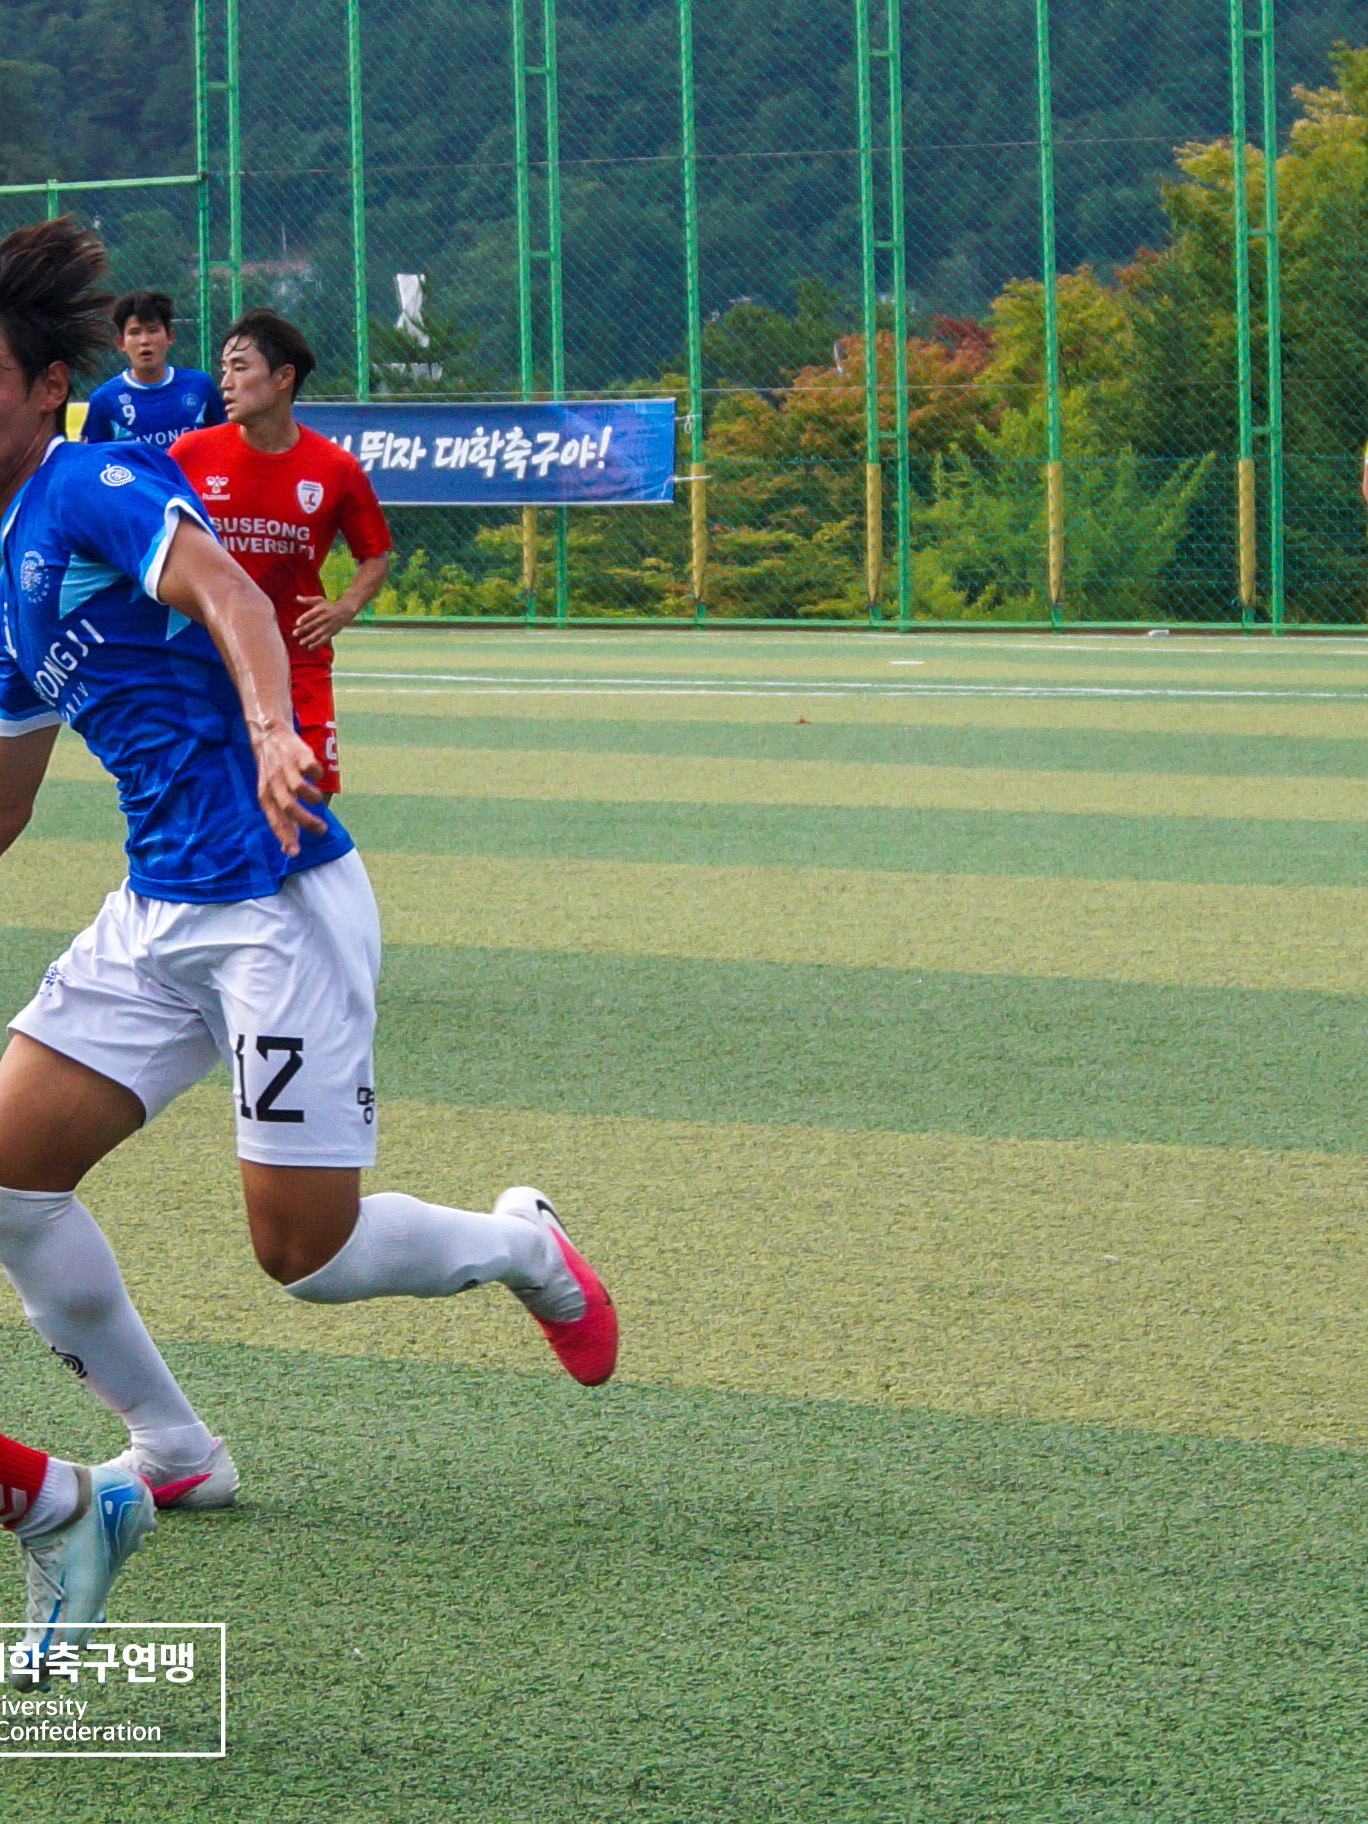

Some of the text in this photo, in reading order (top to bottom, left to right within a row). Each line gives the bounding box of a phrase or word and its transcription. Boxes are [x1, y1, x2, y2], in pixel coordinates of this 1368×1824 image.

[122, 404, 136, 426] 9
[360, 425, 613, 479] 뛰자 대학축구야!
[211, 517, 310, 541] SUSEONG
[235, 1034, 305, 1123] 12
